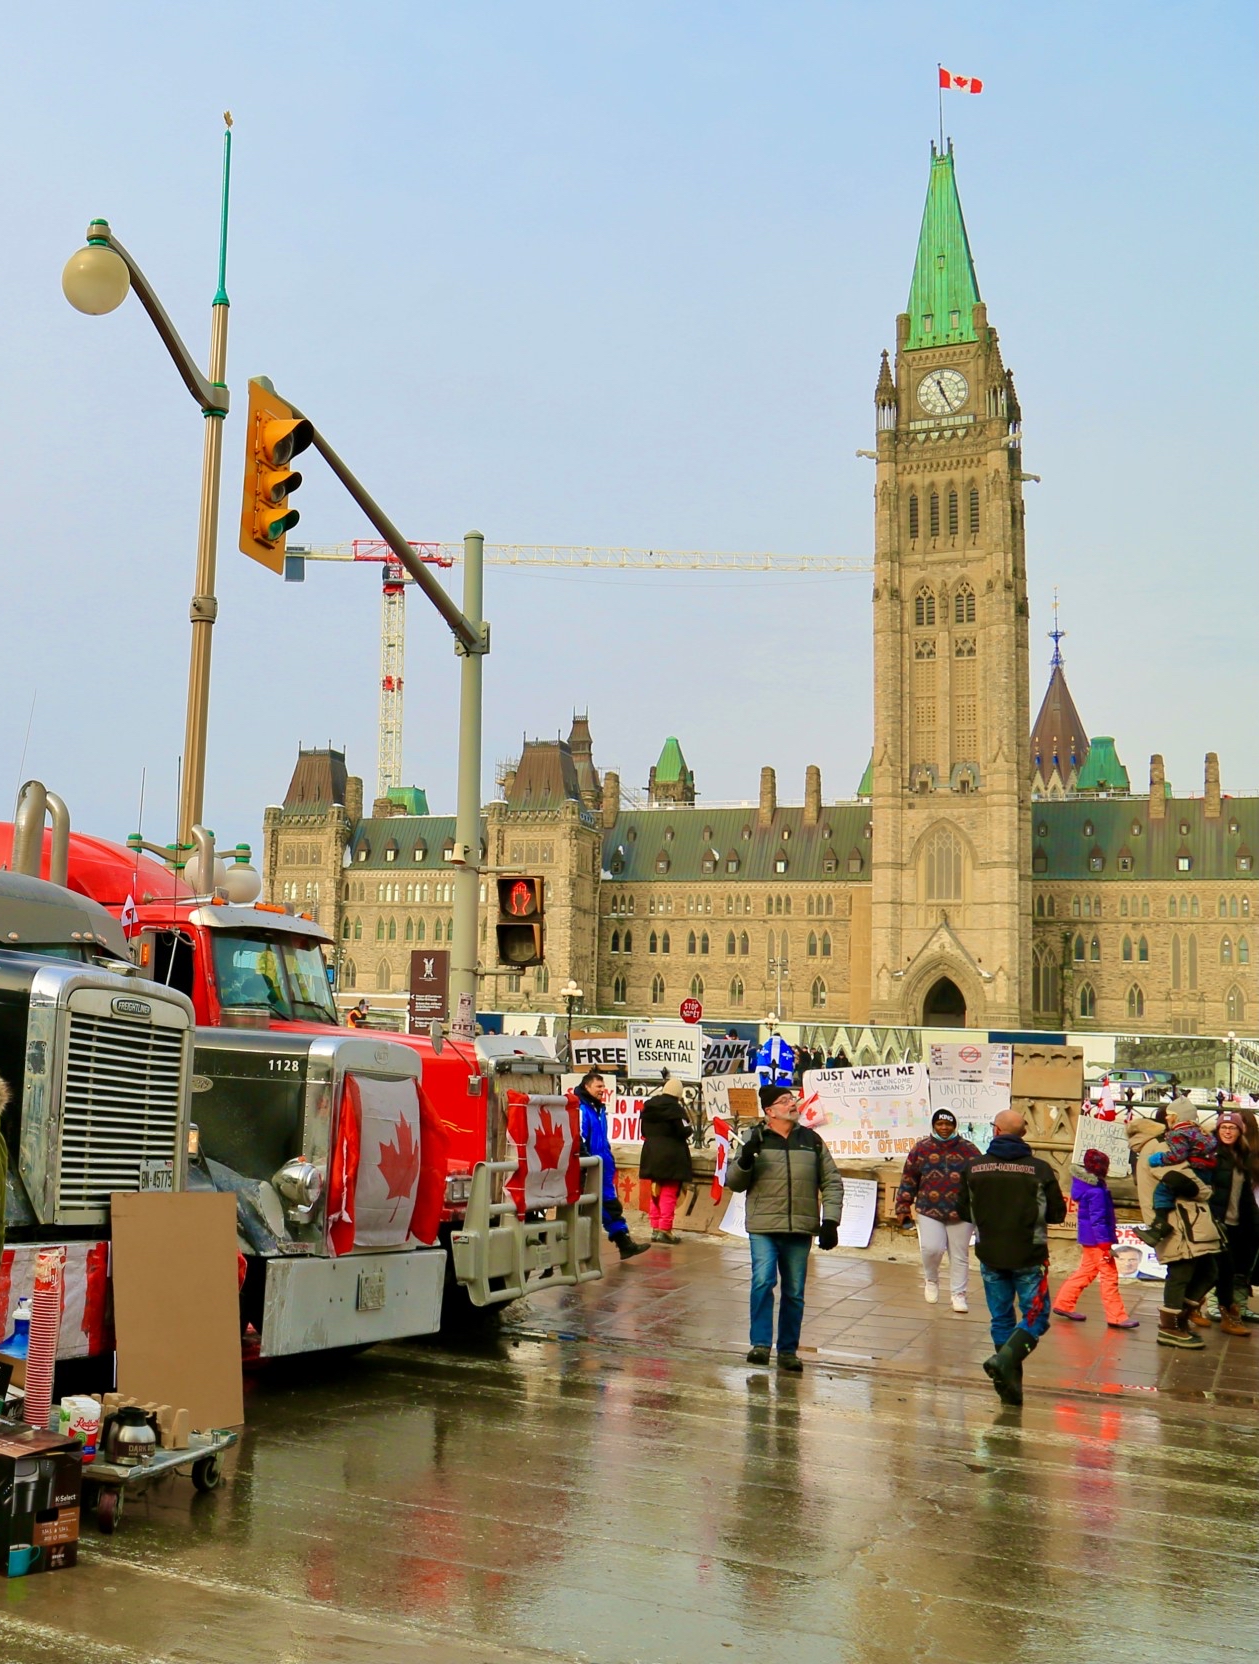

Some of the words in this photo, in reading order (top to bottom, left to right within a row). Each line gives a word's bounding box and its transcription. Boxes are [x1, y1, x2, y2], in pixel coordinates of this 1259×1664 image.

[117, 1000, 151, 1015] FREIGHTLINER
[684, 1002, 699, 1010] STOP
[635, 1038, 653, 1049] WE
[655, 1039, 675, 1050] ARE
[678, 1040, 696, 1051] ALL
[638, 1051, 693, 1063] ESSENTIAL
[702, 1044, 749, 1060] HANK
[268, 1059, 300, 1072] 1128
[817, 1071, 845, 1082] JUST
[852, 1068, 891, 1080] WATCH
[897, 1066, 915, 1076] ME
[940, 1084, 978, 1096] UNITED
[981, 1085, 998, 1097] AS
[951, 1098, 979, 1109] ONE
[939, 1114, 954, 1122] KING
[1083, 1120, 1099, 1132] MY
[852, 1131, 863, 1140] IS
[867, 1130, 890, 1139] THIS
[826, 1140, 871, 1155] ELPING
[971, 1162, 1036, 1175] HARLEY-DAVIDSON
[128, 1444, 147, 1453] DARK
